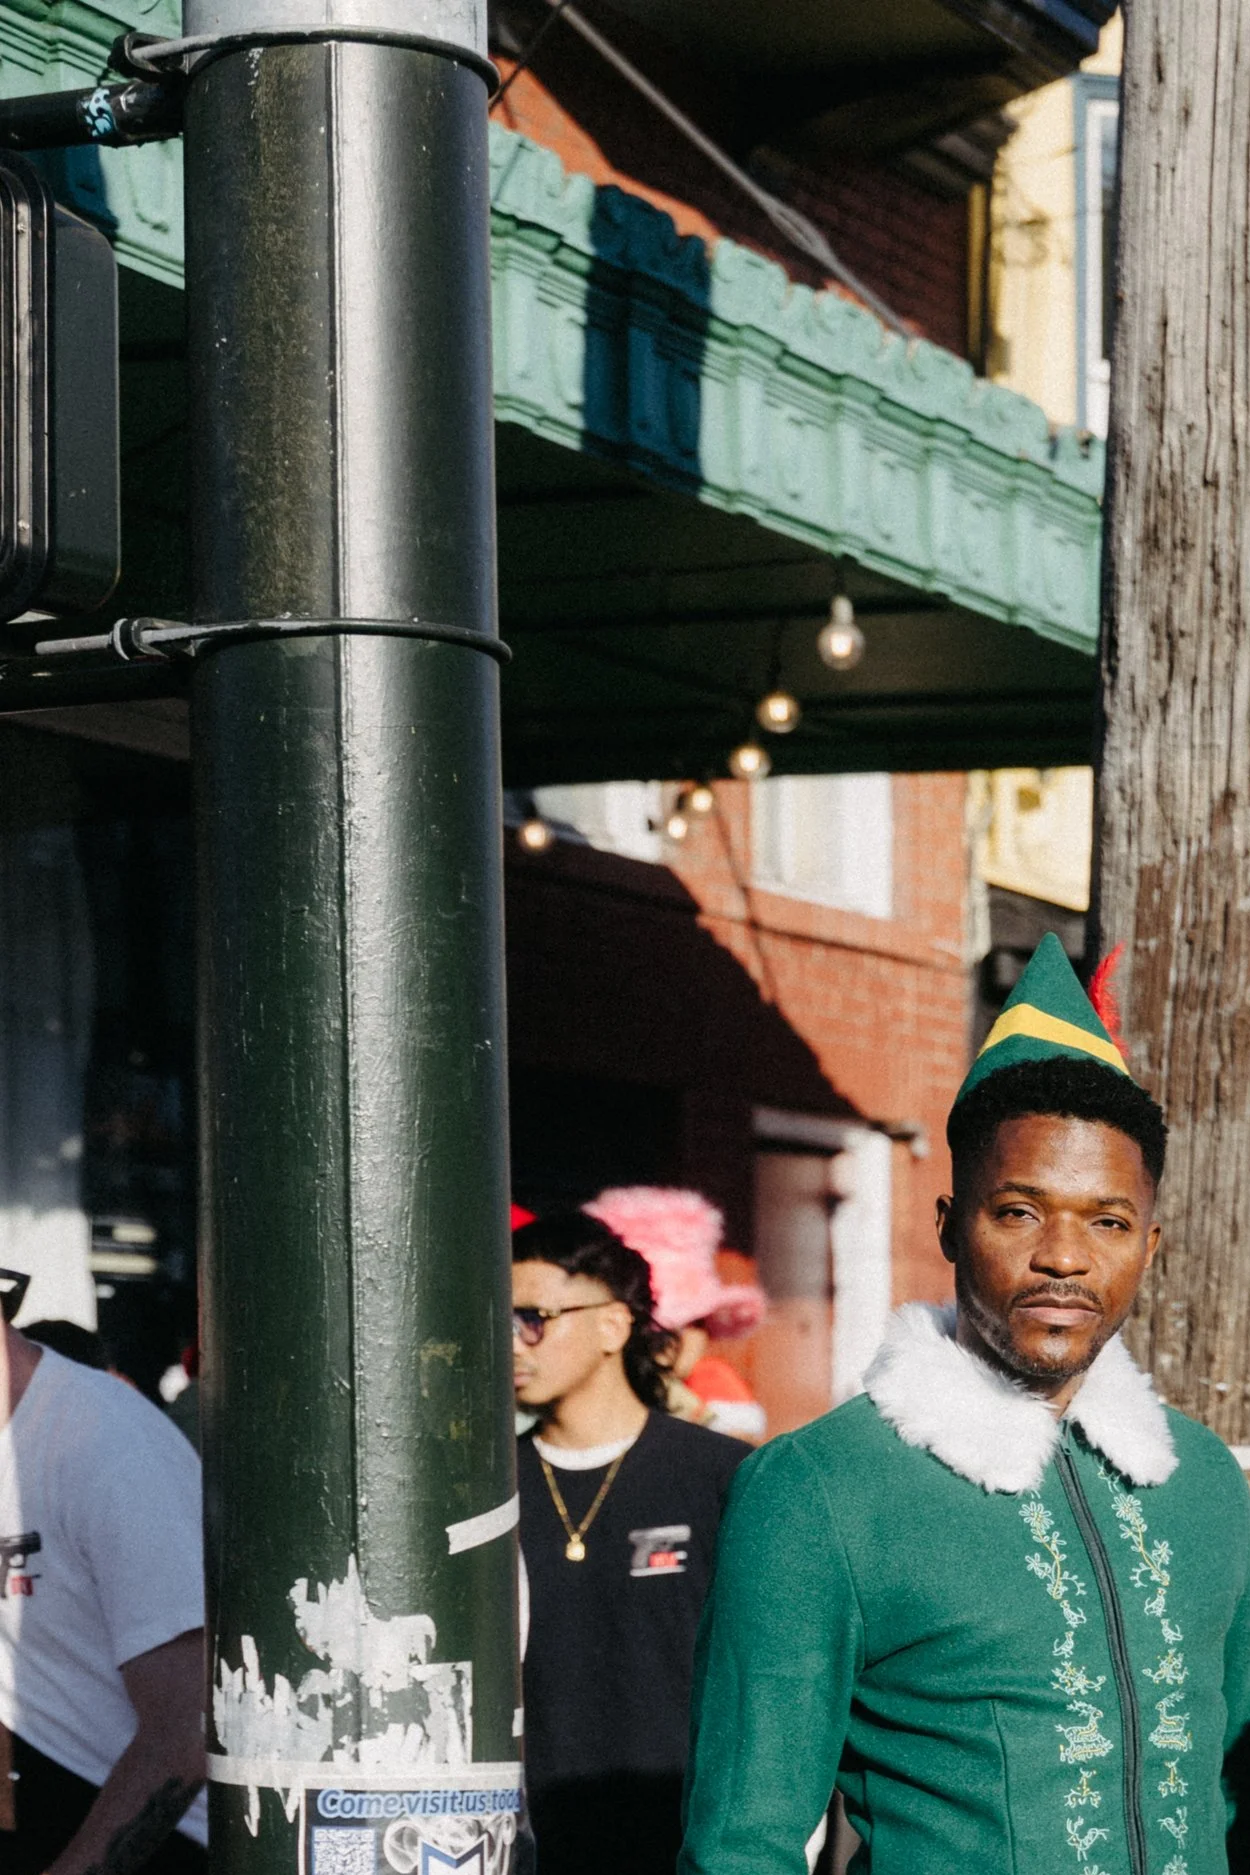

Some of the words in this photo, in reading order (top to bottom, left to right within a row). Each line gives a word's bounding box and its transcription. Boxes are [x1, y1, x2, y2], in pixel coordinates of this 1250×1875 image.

[319, 1789, 401, 1815] Come
[404, 1790, 459, 1815] visit
[464, 1790, 488, 1812] us
